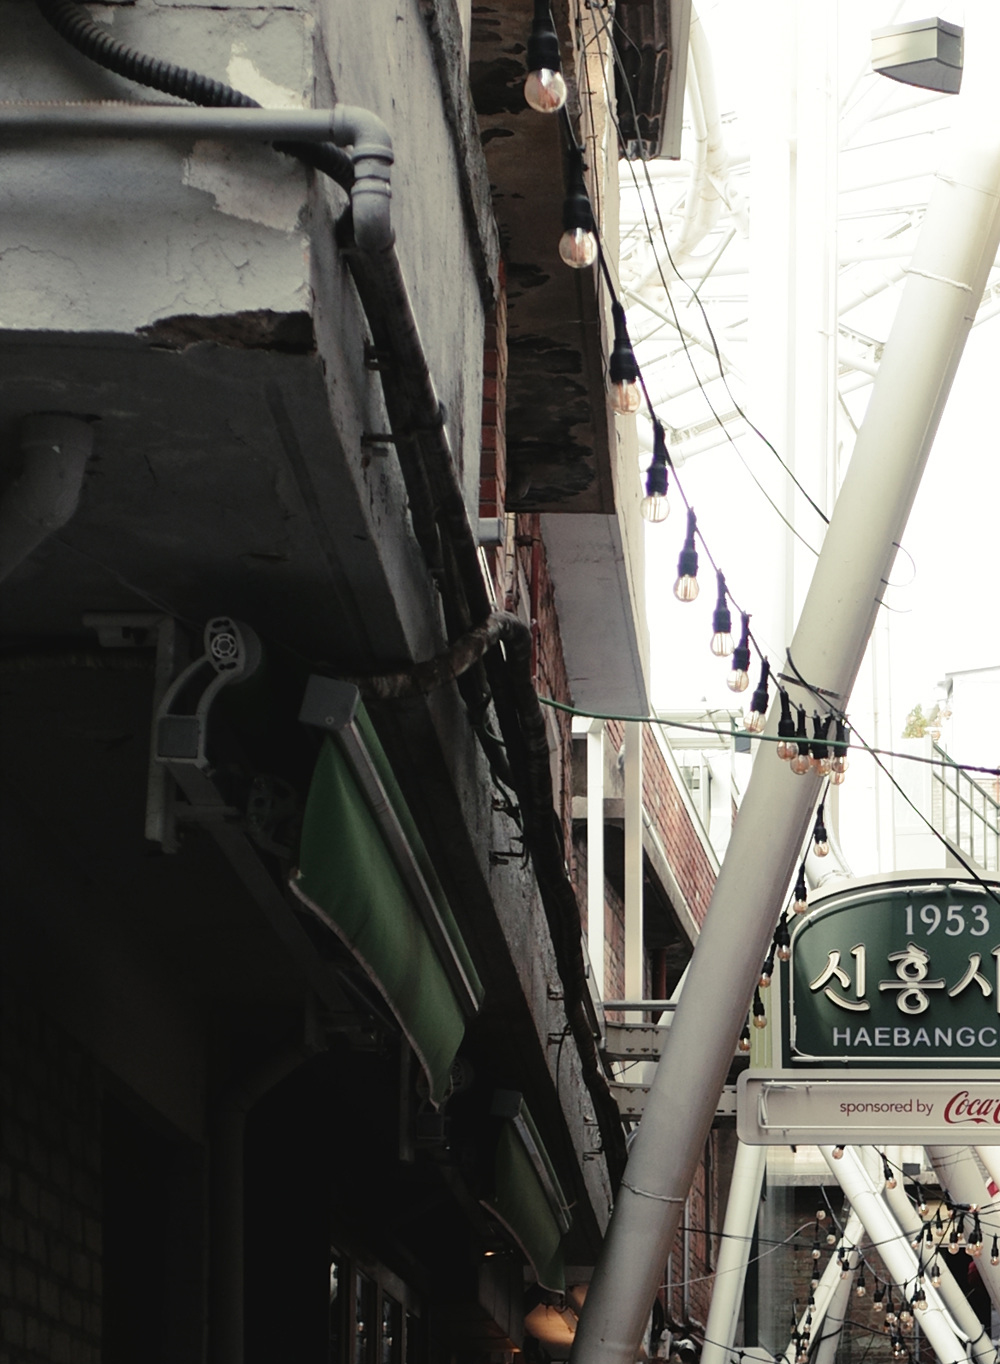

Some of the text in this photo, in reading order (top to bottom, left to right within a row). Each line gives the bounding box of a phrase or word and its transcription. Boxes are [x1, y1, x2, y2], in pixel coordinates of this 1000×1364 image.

[904, 904, 990, 937] 1953
[839, 1099, 913, 1117] sponsored
[916, 1099, 934, 1117] by
